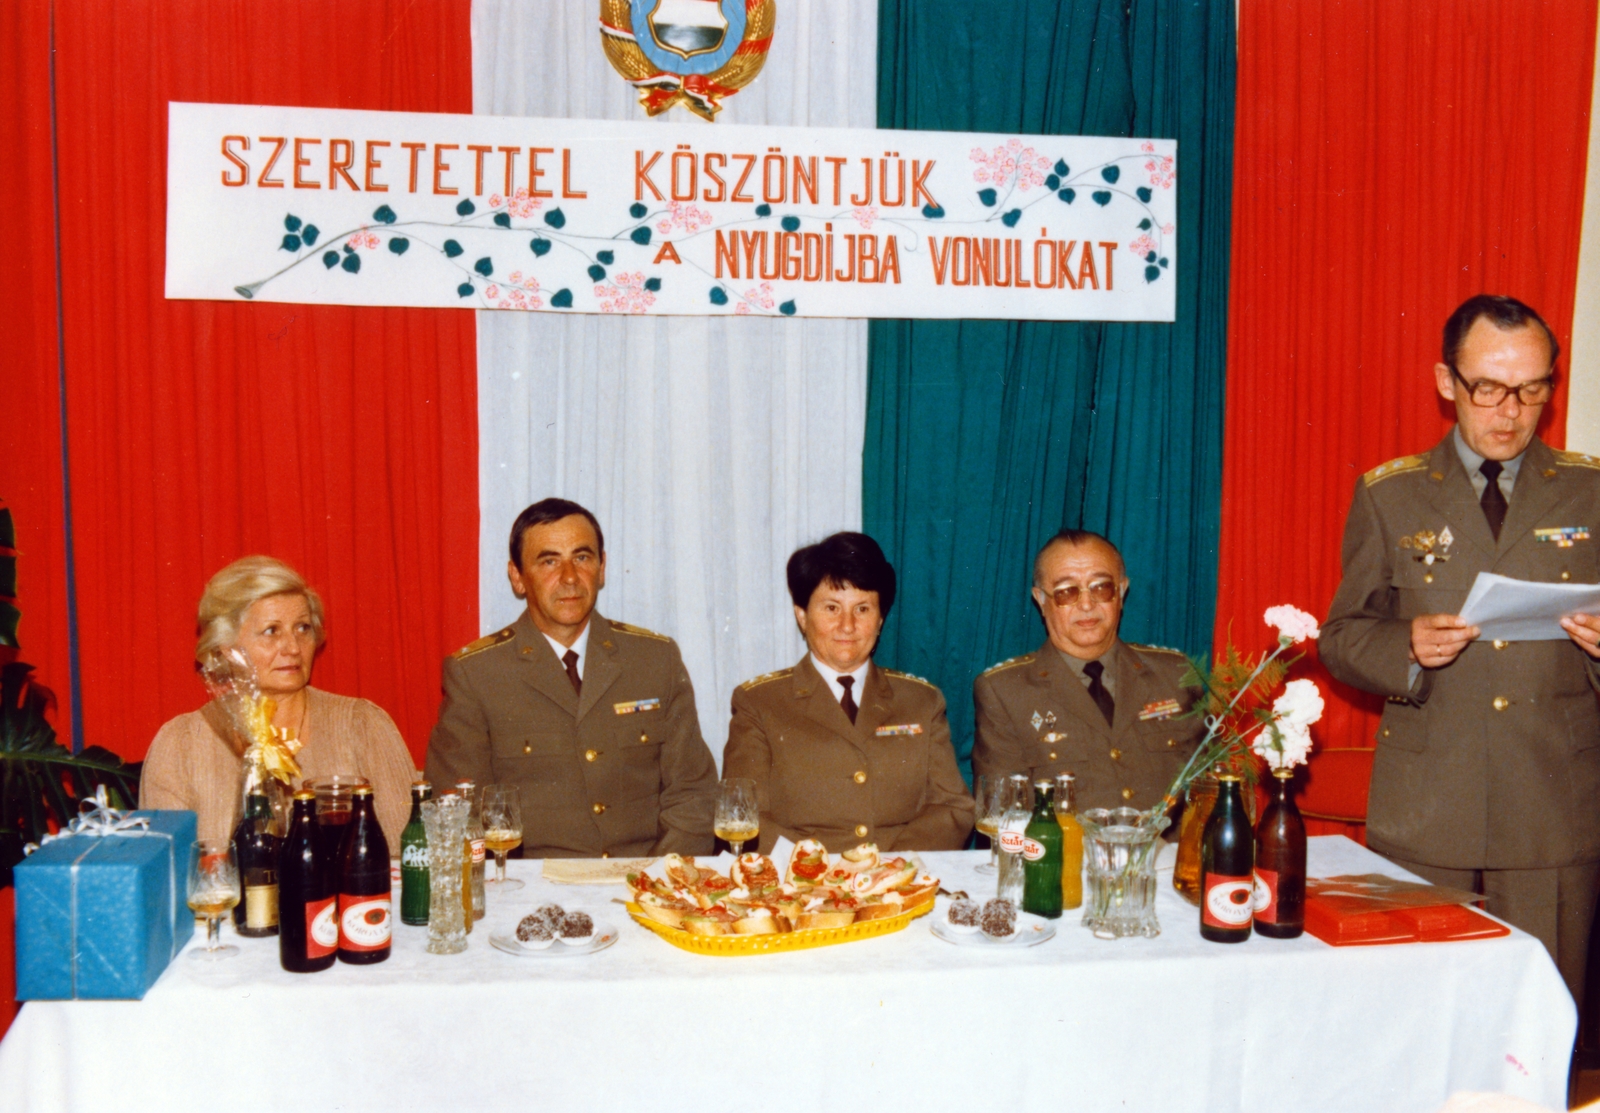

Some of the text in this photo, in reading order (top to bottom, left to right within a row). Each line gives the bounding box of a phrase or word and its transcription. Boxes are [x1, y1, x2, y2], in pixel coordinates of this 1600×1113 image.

[220, 135, 940, 208] SZERETETTEL KÖSZÖNTJÜK
[653, 222, 1118, 291] A NYUGDÍJBA VONULÓKAT
